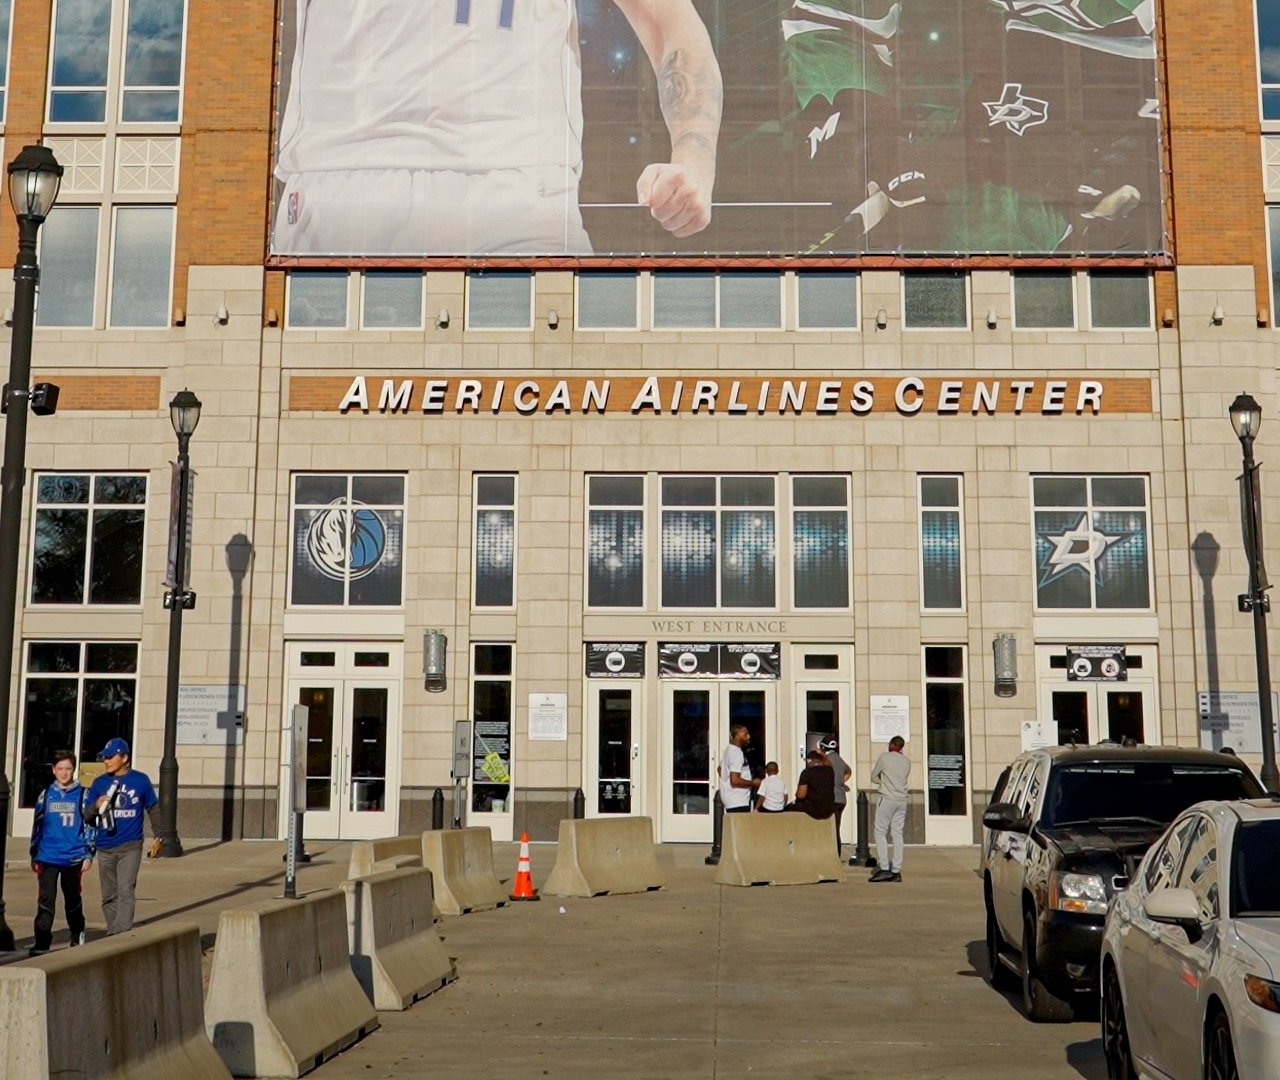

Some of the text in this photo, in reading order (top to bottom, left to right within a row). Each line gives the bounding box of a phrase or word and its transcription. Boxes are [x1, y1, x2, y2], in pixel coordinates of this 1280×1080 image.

[339, 376, 1104, 415] AMERICAN AIRLINES CENTER
[652, 621, 788, 633] WEST ENTRANCE
